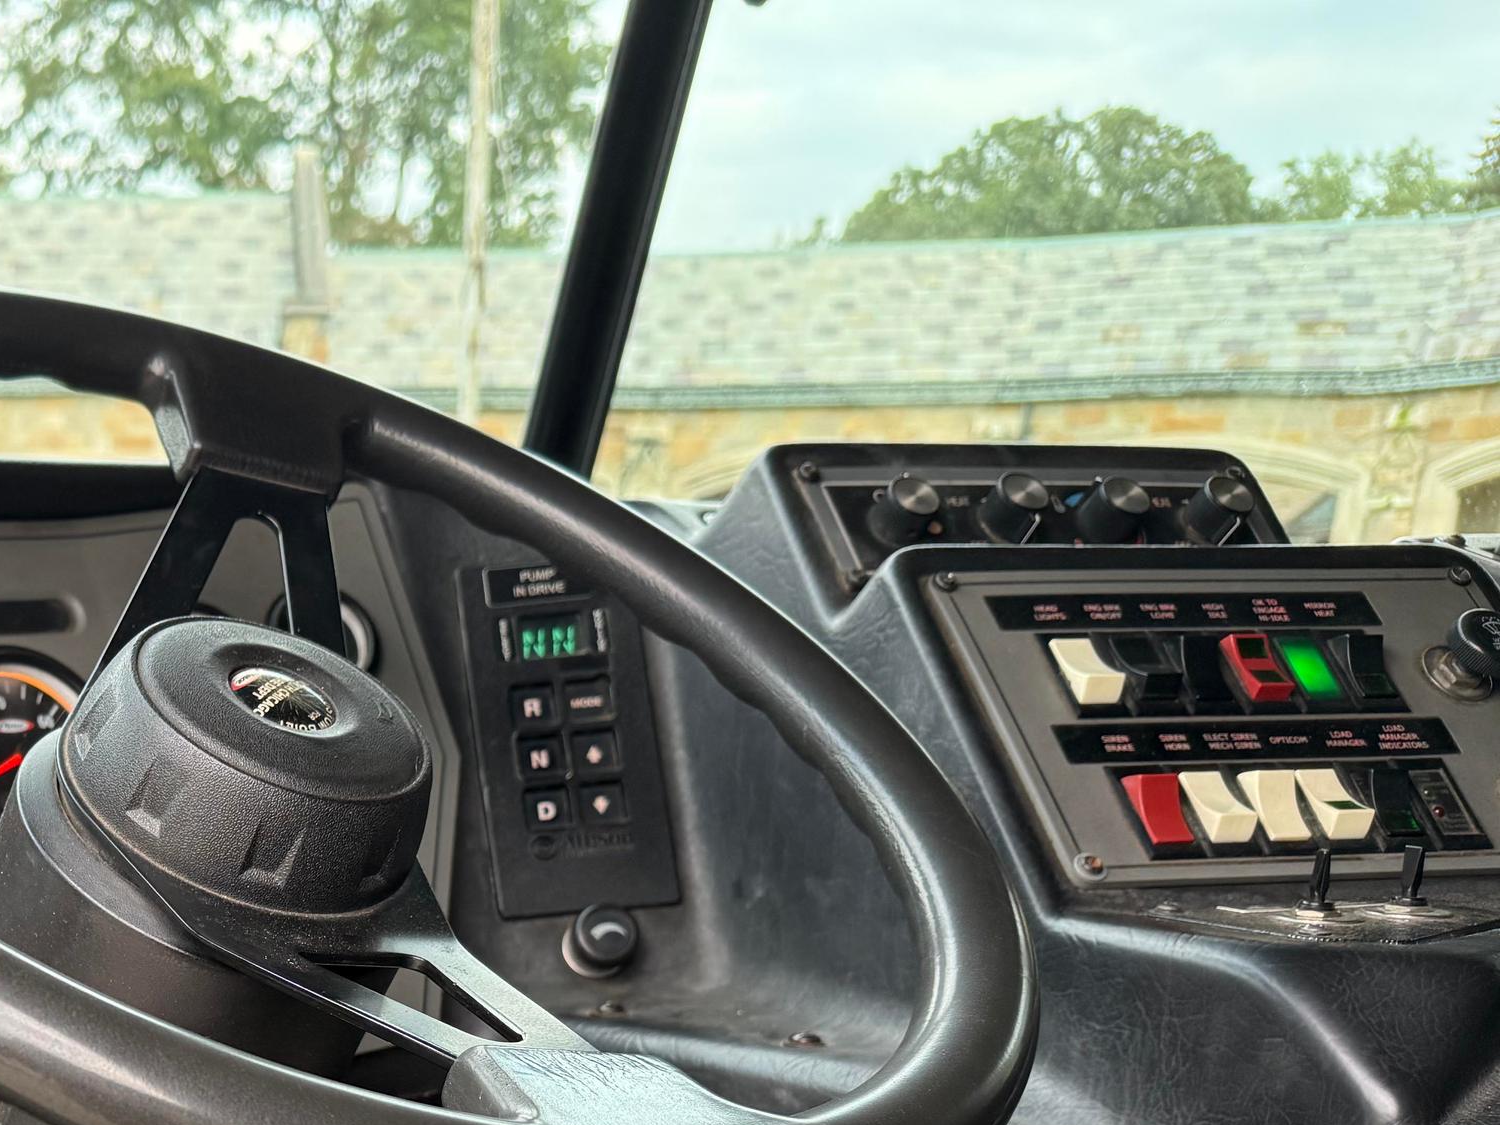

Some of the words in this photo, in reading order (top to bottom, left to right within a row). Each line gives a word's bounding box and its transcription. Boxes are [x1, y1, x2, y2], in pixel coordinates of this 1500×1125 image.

[519, 566, 557, 583] PUMP
[513, 586, 528, 598] IN
[528, 580, 567, 596] DRIVE
[524, 698, 542, 718] R
[1382, 724, 1405, 732] LOAD
[1101, 735, 1130, 743] SIREN
[1159, 734, 1187, 742] SIREN
[1203, 733, 1229, 742] ELECT
[1230, 733, 1258, 741] SIREN
[1329, 731, 1353, 739] LOAD
[1379, 733, 1420, 741] MANAGER
[1164, 743, 1191, 751] HORN
[1234, 742, 1262, 750] SIREN
[1325, 739, 1367, 747] MANAGER
[1378, 742, 1429, 750] INDICATORS
[530, 749, 549, 769] N
[537, 801, 557, 821] D
